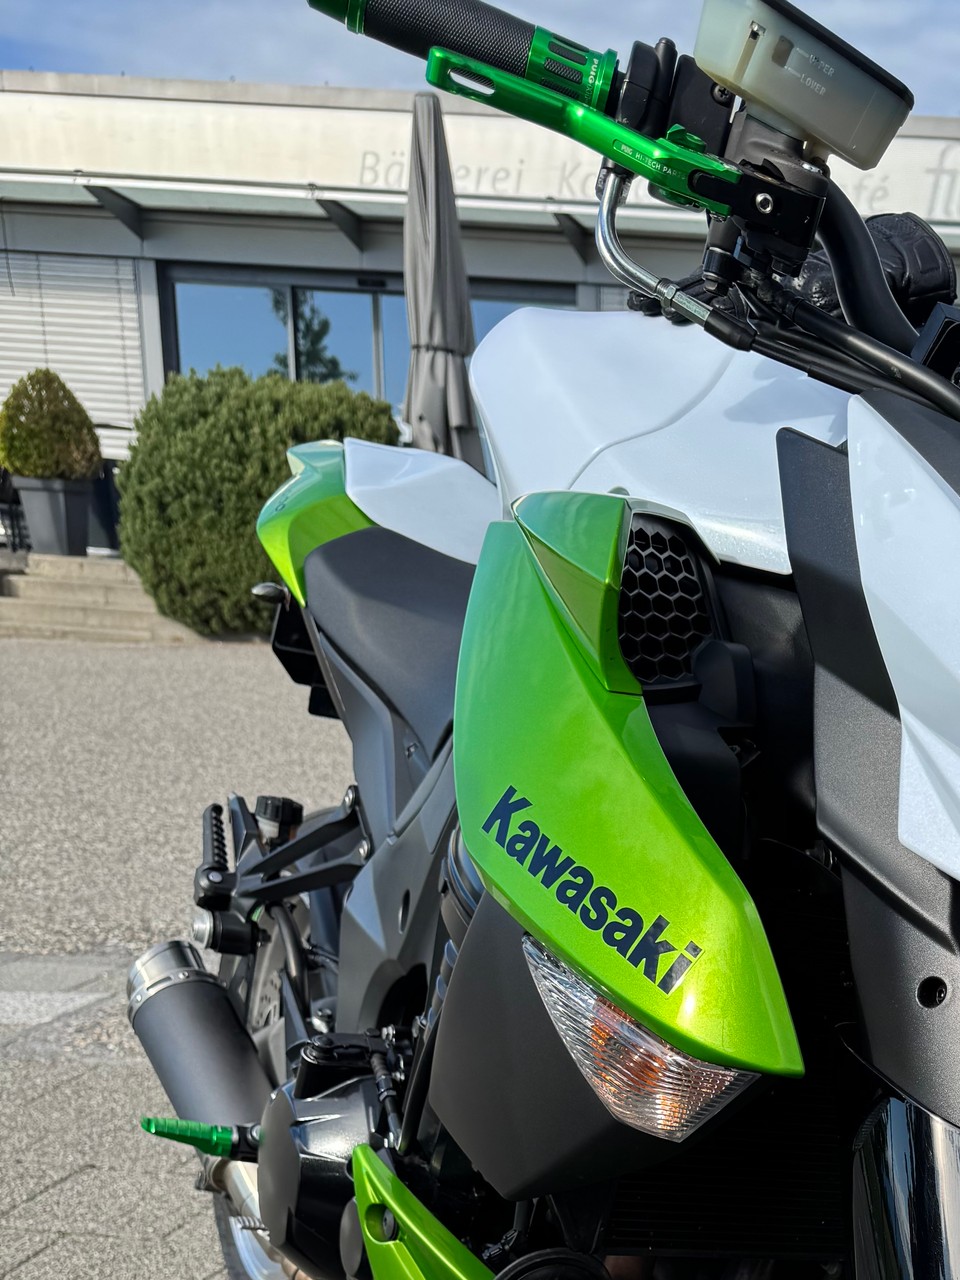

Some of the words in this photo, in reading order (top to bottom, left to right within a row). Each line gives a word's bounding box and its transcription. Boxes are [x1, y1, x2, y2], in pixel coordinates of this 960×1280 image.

[588, 58, 599, 84] PUIG
[809, 54, 835, 77] UPER
[359, 149, 525, 193] Bäerei
[635, 152, 661, 171] HI-TECH
[662, 165, 686, 180] PAR
[481, 785, 704, 996] Kawasaki
